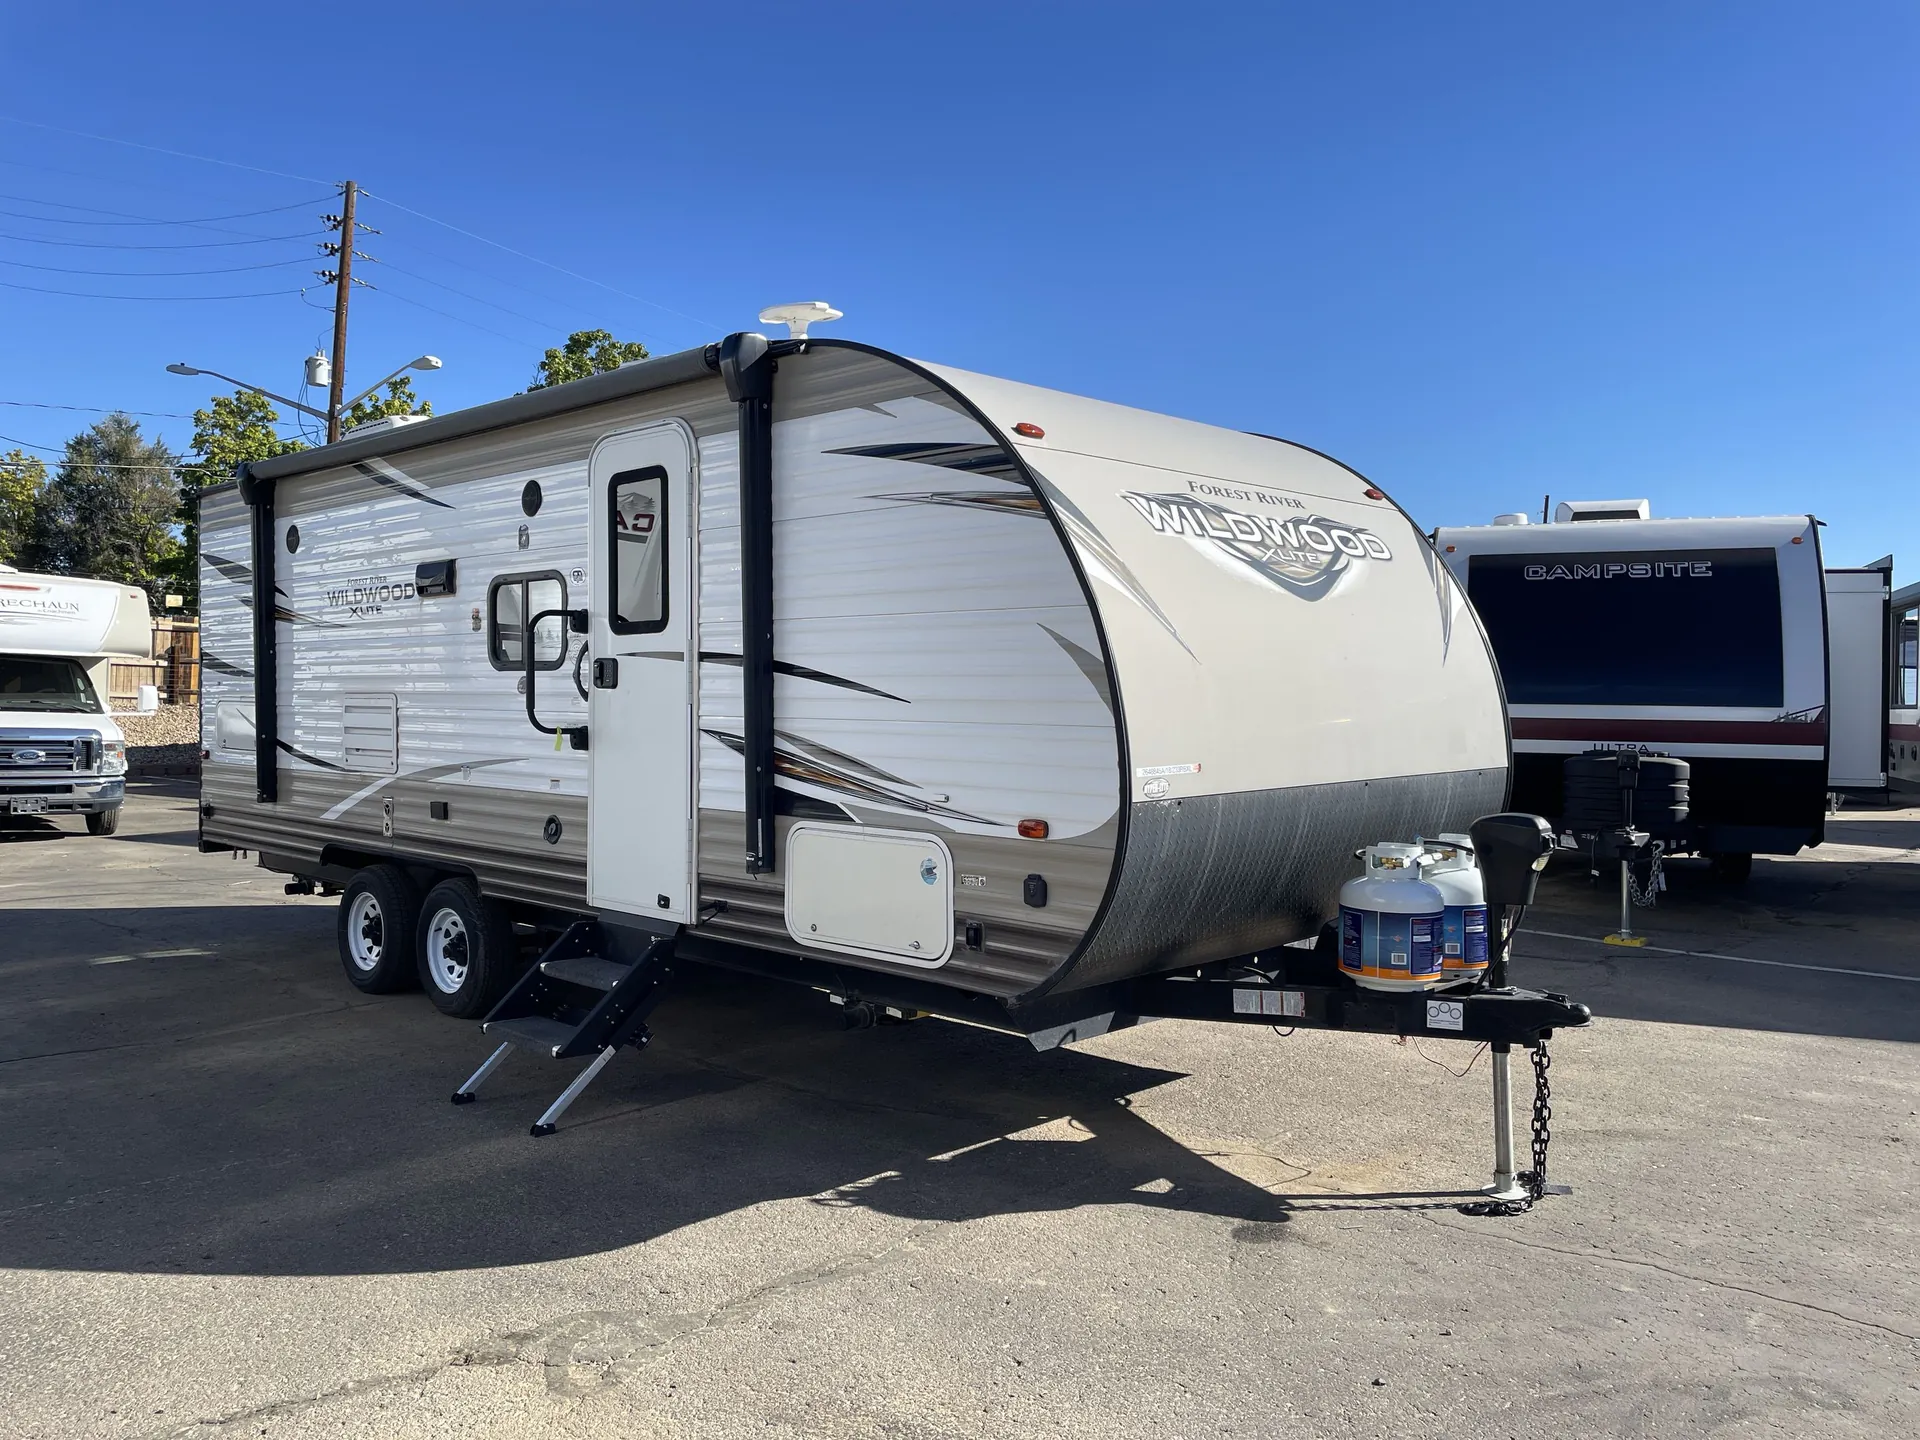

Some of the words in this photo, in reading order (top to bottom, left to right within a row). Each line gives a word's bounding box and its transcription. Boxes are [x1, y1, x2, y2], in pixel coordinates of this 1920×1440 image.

[1187, 480, 1251, 501] FOREST
[1254, 491, 1307, 510] RIVER
[1122, 494, 1393, 562] WILDWOOD
[1524, 561, 1713, 580] CAMPSITE
[327, 582, 416, 607] WILDWOOD
